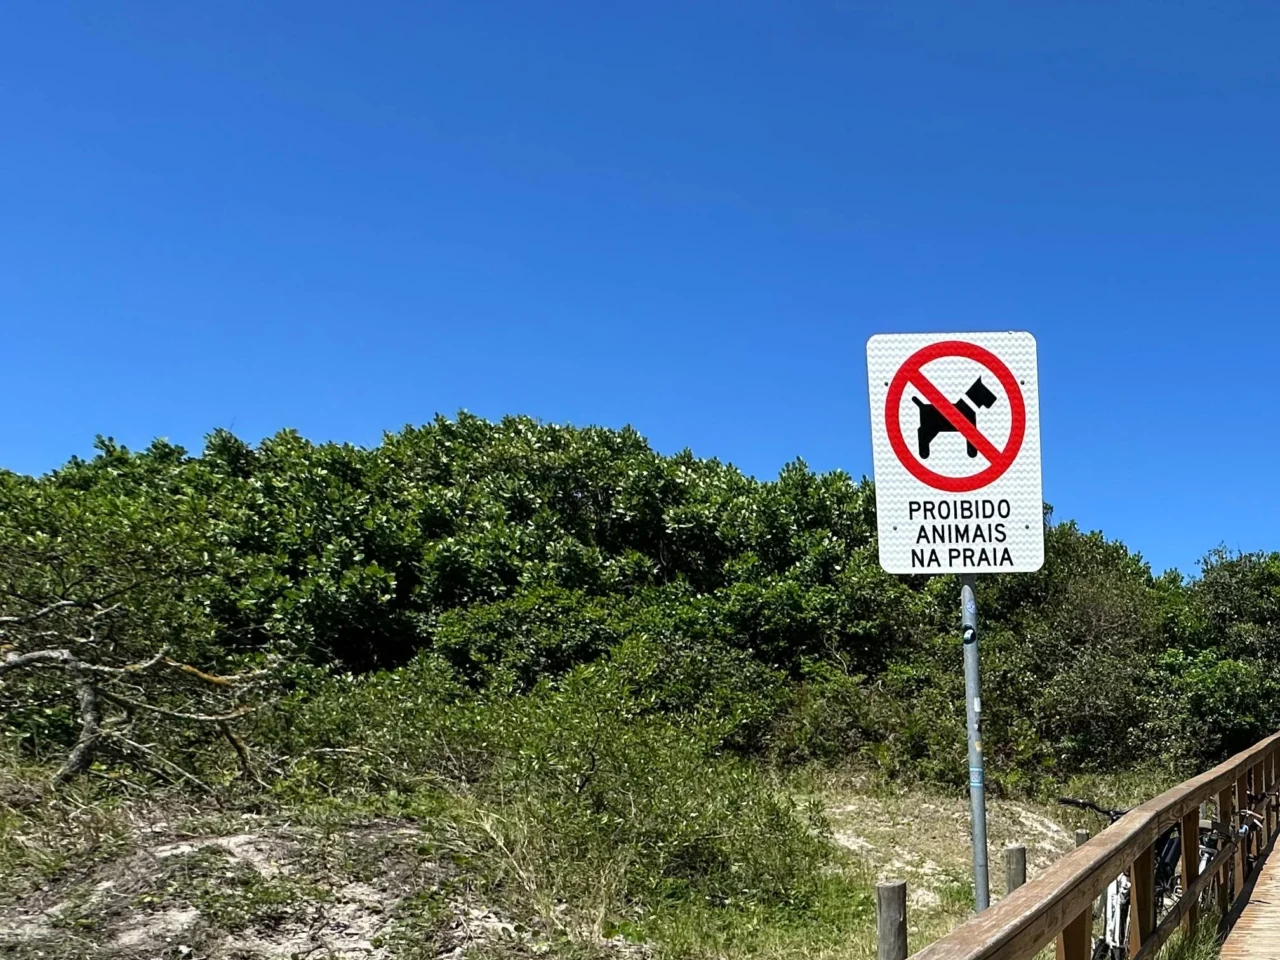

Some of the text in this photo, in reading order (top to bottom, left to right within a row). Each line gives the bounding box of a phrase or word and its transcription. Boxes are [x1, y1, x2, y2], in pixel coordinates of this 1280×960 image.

[908, 499, 1011, 520] PROIBIDO
[916, 523, 1007, 544] ANIMAIS
[911, 547, 1014, 568] NA PRAIA
